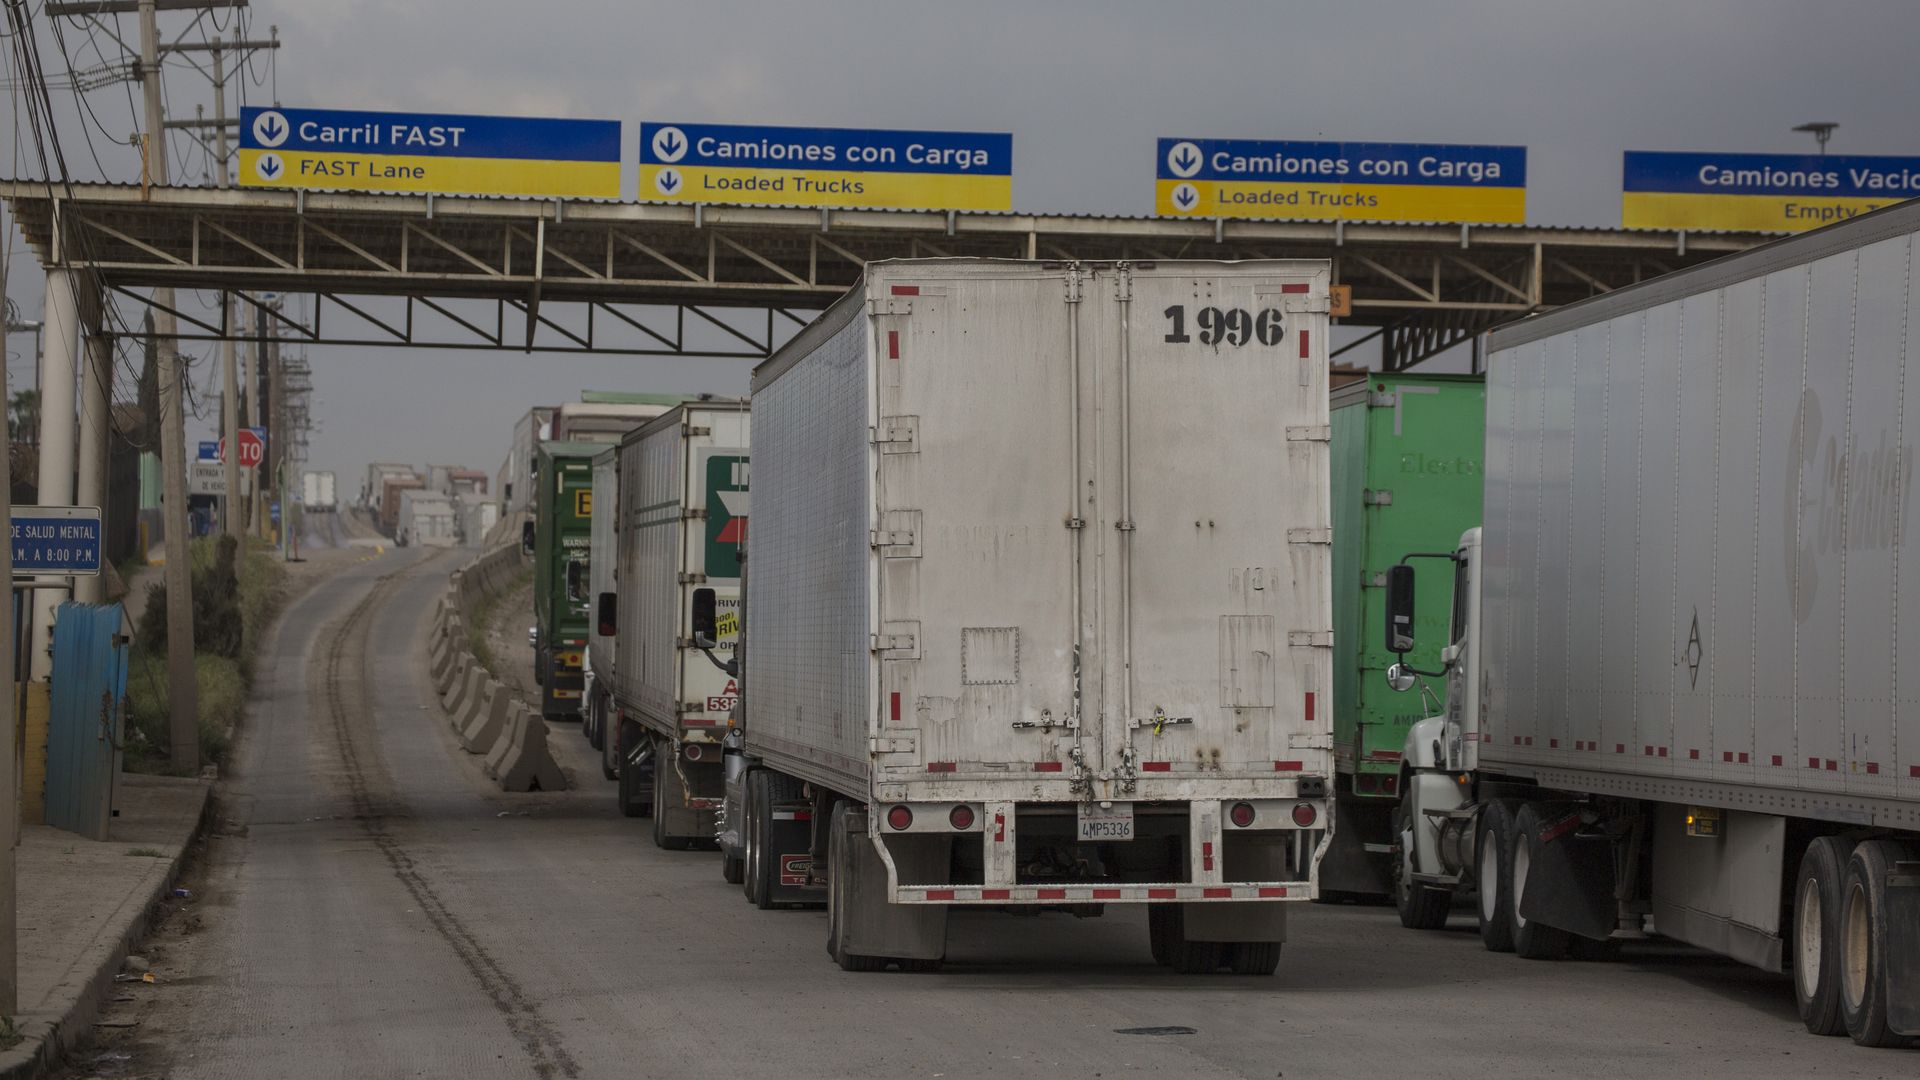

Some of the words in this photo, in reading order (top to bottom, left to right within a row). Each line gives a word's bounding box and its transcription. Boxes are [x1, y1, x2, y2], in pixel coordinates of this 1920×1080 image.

[299, 121, 381, 146] Carril
[391, 125, 466, 148] FAST
[696, 136, 837, 162] Camiones
[846, 144, 896, 163] con
[905, 143, 989, 170] Carga
[300, 159, 361, 178] FAST
[369, 162, 426, 180] Lane
[1211, 151, 1350, 175] Camiones
[1358, 158, 1409, 177] con
[1418, 156, 1502, 182] Carga
[1699, 164, 1840, 189] Camiones
[703, 174, 785, 192] Loaded
[792, 176, 865, 194] Trucks
[1219, 188, 1299, 206] Loaded
[1307, 190, 1379, 208] Trucks
[1163, 305, 1284, 347] 1996
[25, 525, 55, 538] SALUD
[60, 526, 95, 539] MENTAL
[34, 548, 41, 561] A
[46, 548, 70, 561] 8:00
[76, 549, 95, 562] P.M.
[1082, 822, 1130, 836] 4MP5336
